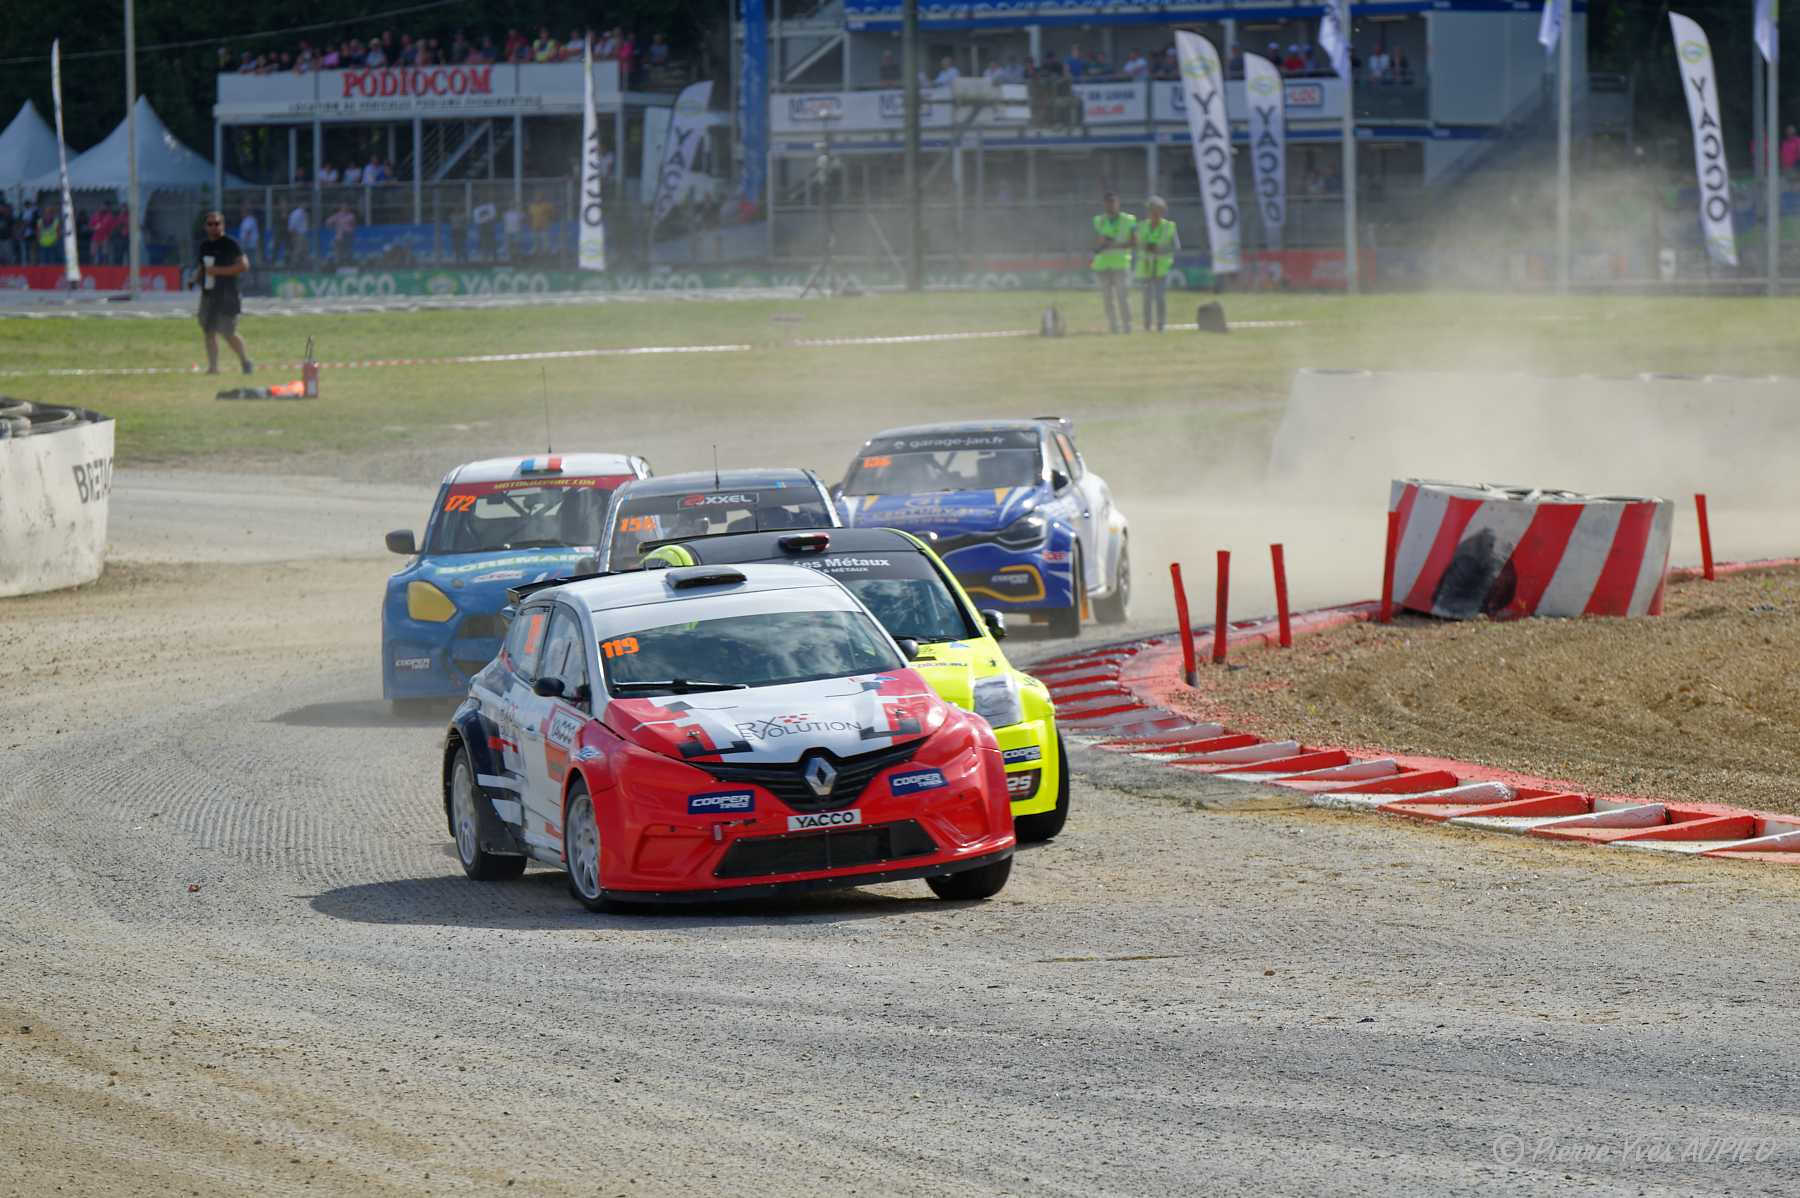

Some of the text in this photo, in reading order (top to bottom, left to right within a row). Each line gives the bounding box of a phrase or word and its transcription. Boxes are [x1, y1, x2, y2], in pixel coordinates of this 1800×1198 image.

[341, 65, 493, 98] PODIOCOM
[310, 273, 396, 298] YACCO
[462, 272, 549, 297] YACCO
[910, 435, 1005, 449] garage-jan.fr
[444, 495, 477, 512] 172
[824, 558, 891, 568] Métaux
[601, 636, 640, 658] 119
[893, 772, 940, 787] COOPER
[691, 794, 751, 807] COOPER
[794, 811, 855, 829] YACCO
